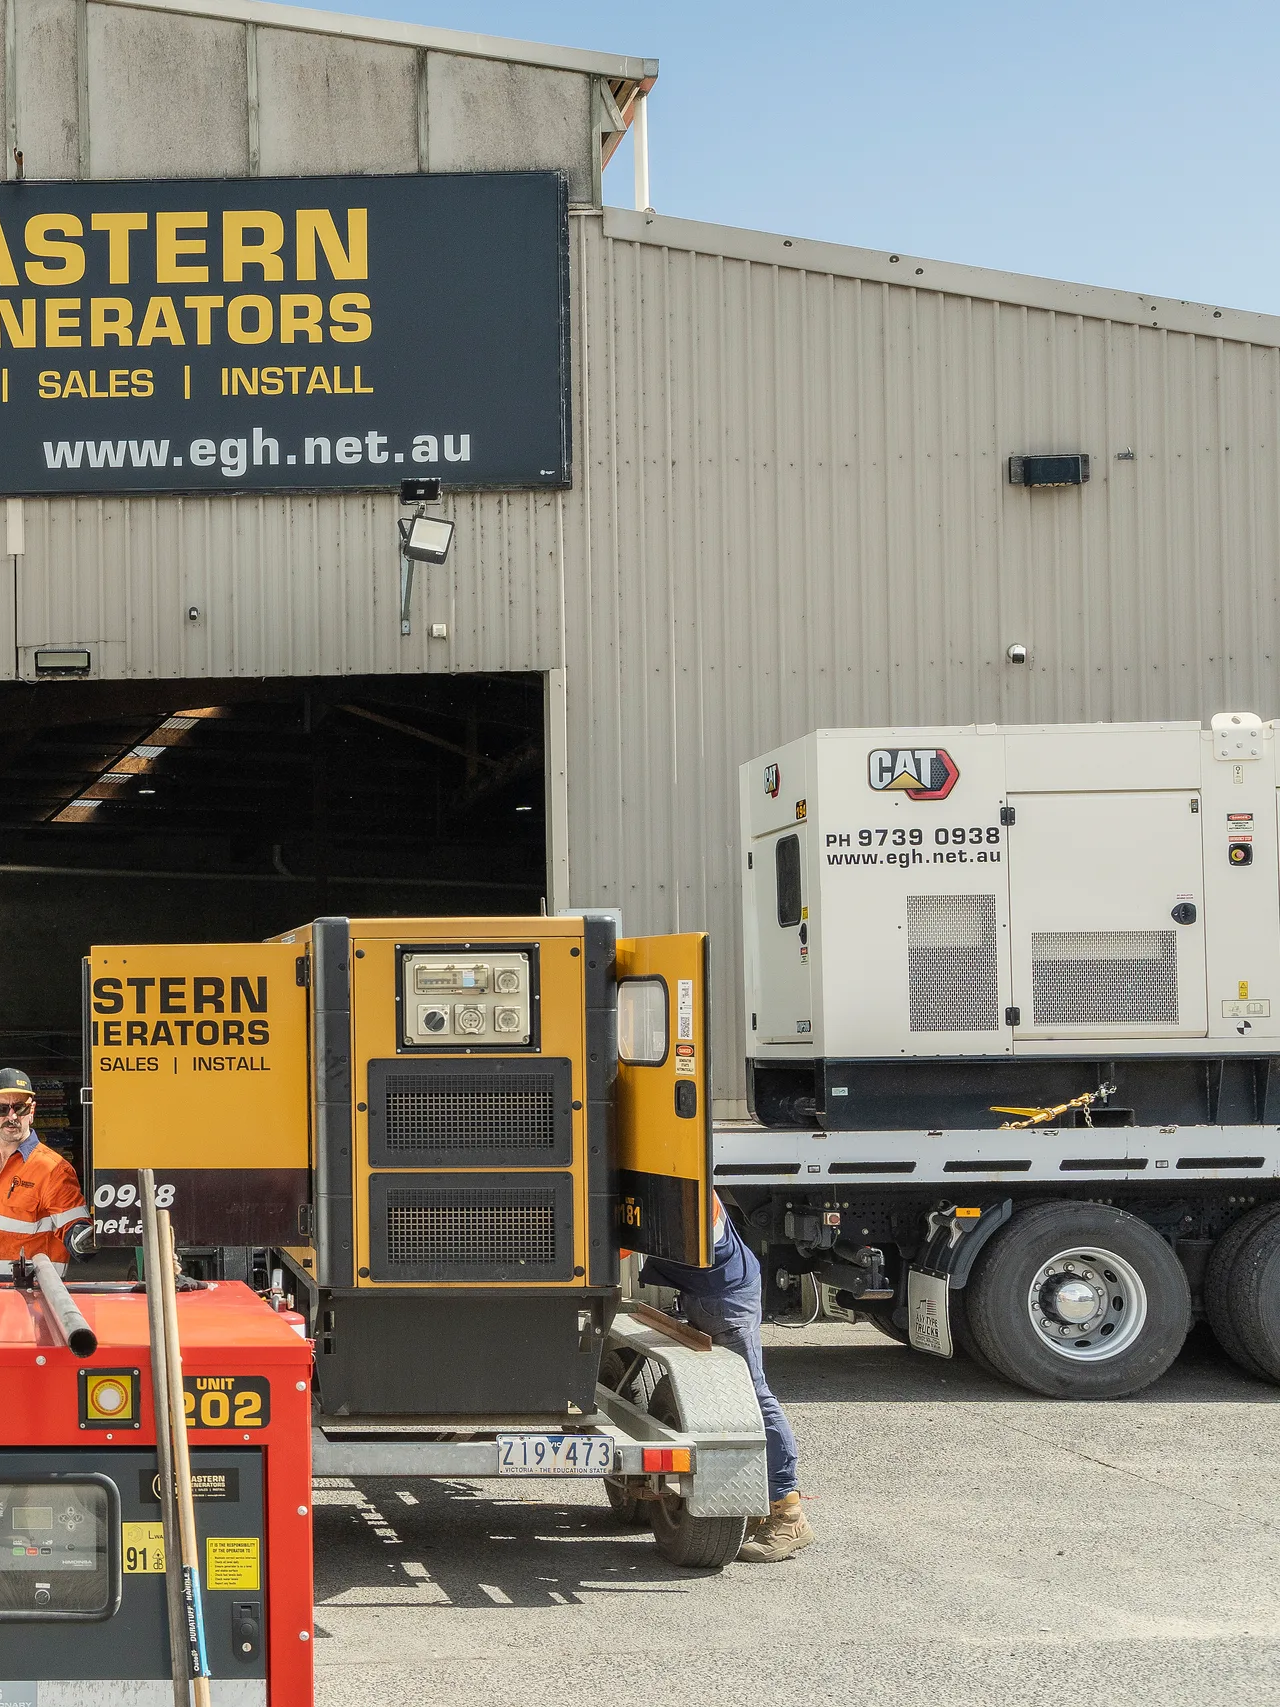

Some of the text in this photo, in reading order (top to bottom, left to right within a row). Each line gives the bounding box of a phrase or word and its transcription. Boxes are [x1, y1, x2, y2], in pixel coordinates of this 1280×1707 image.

[38, 369, 154, 398] SALES
[222, 365, 373, 396] INSTALL
[43, 427, 470, 477] www.egh.net.au
[870, 750, 936, 789] CAT
[826, 827, 1000, 847] PH 9739 0938
[827, 849, 1001, 868] www.egh.net.au
[100, 1056, 271, 1072] SALES INSTALL
[197, 1378, 235, 1391] UNIT
[503, 1441, 610, 1467] Z19 473
[191, 1475, 226, 1483] ASTERN
[126, 1546, 147, 1571] 91
